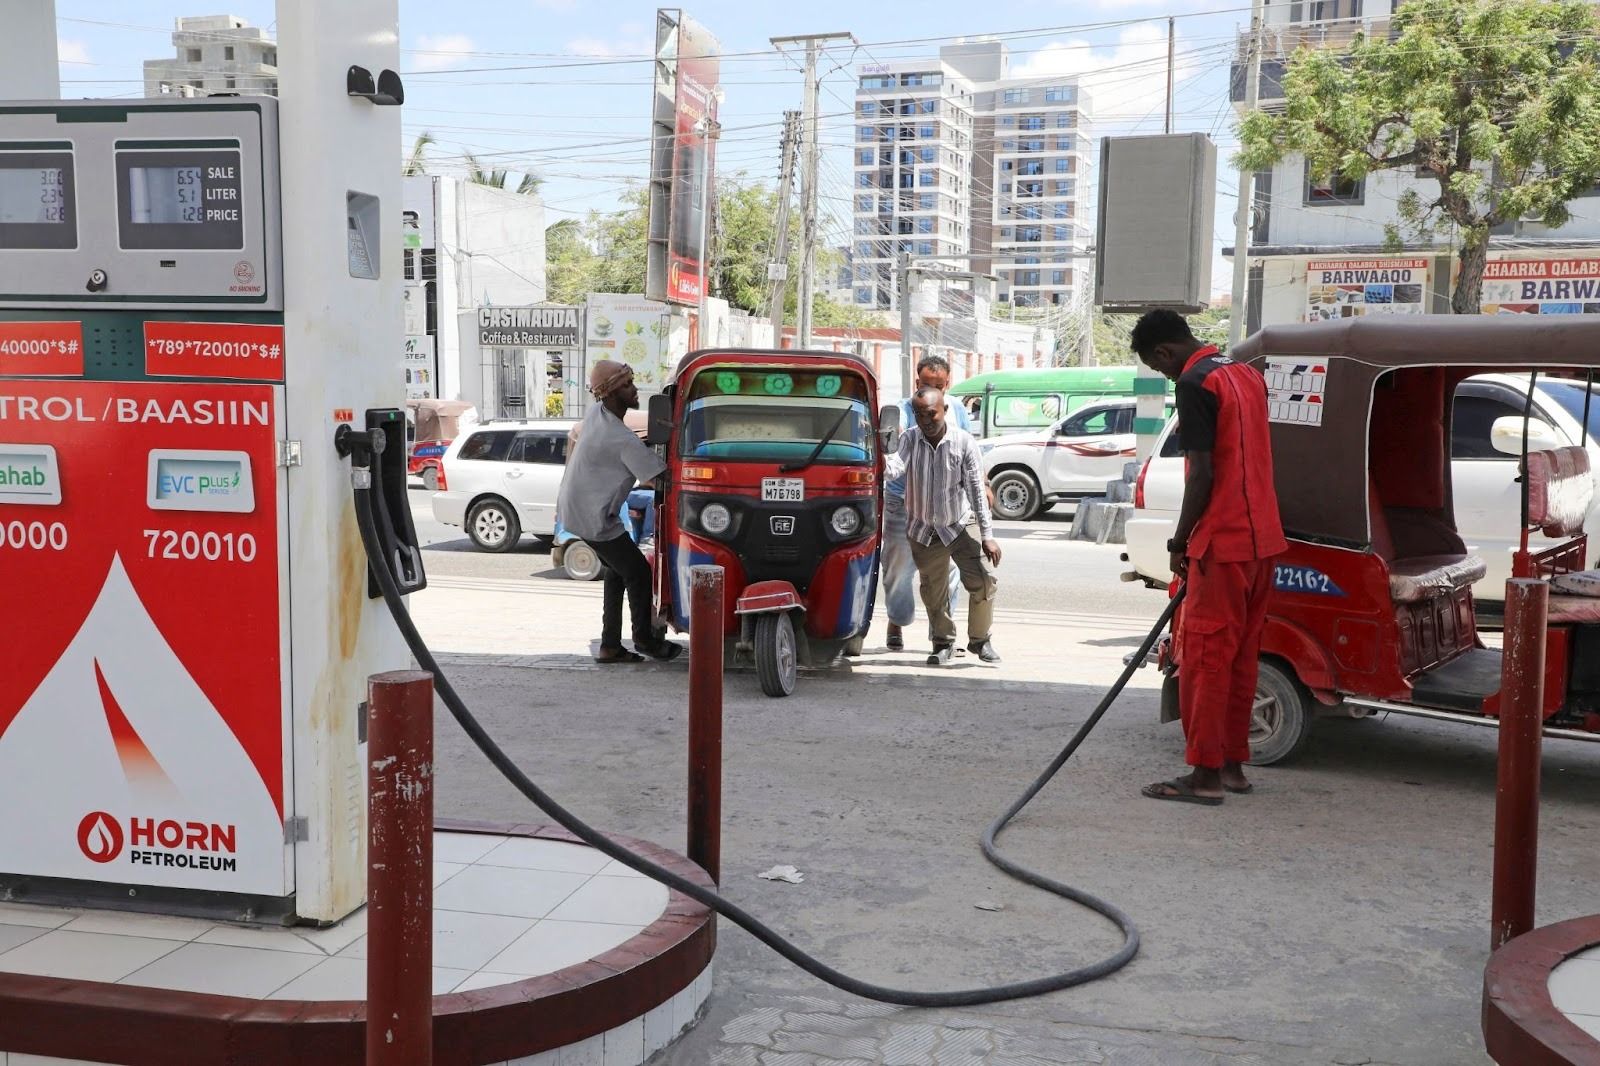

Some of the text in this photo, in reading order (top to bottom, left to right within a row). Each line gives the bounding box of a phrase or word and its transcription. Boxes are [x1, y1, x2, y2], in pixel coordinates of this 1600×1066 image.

[208, 167, 234, 179] SALE
[206, 188, 237, 200] LITER
[206, 209, 238, 221] PRICE
[1551, 261, 1600, 276] QALAB
[1322, 270, 1412, 284] BARWAAQO
[479, 308, 577, 328] CASIMADDA
[481, 331, 512, 344] Coffee
[514, 331, 520, 344] &
[521, 331, 575, 344] Restaurant
[160, 475, 194, 493] EVC
[774, 522, 791, 532] RE
[0, 520, 68, 551] 000
[143, 529, 257, 563] 720010
[1275, 566, 1329, 592] 22162
[130, 817, 236, 853] HORN
[131, 850, 236, 872] PETROLEUM
